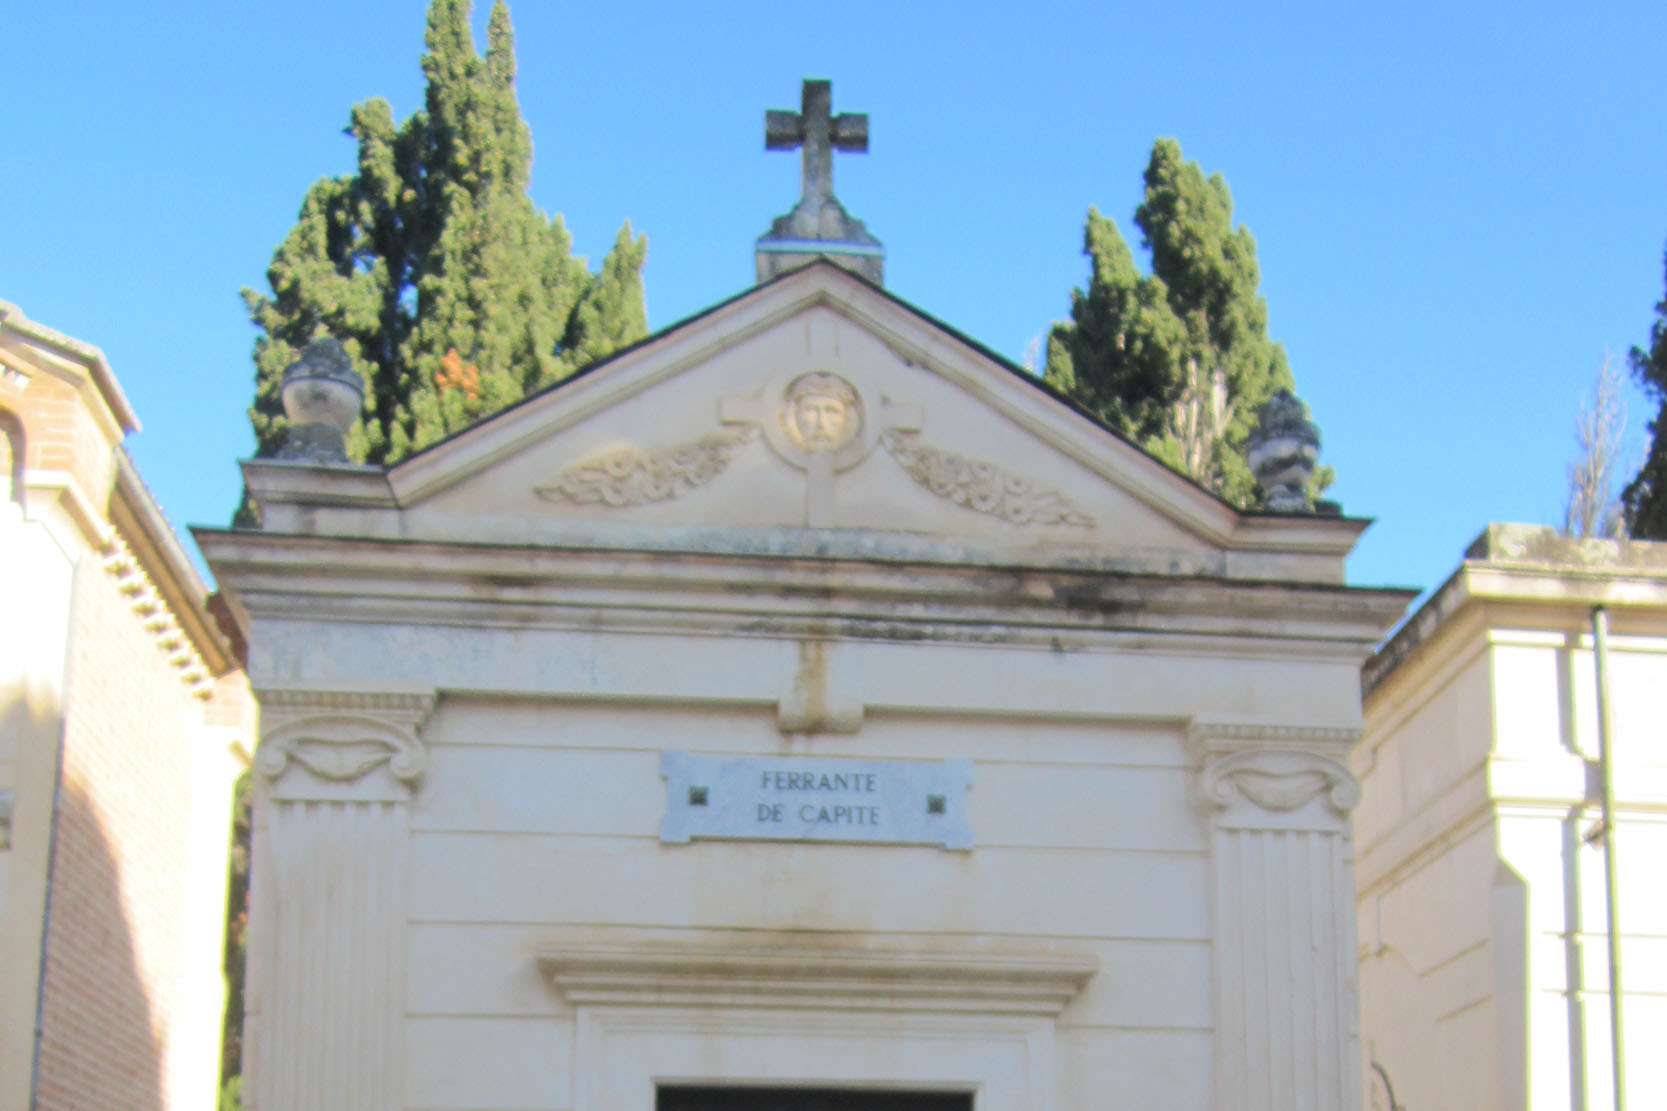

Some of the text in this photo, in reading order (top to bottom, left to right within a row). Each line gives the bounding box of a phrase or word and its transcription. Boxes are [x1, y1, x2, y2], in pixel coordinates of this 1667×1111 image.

[762, 771, 877, 791] FERRANTE
[757, 804, 880, 824] DE CAPITE
